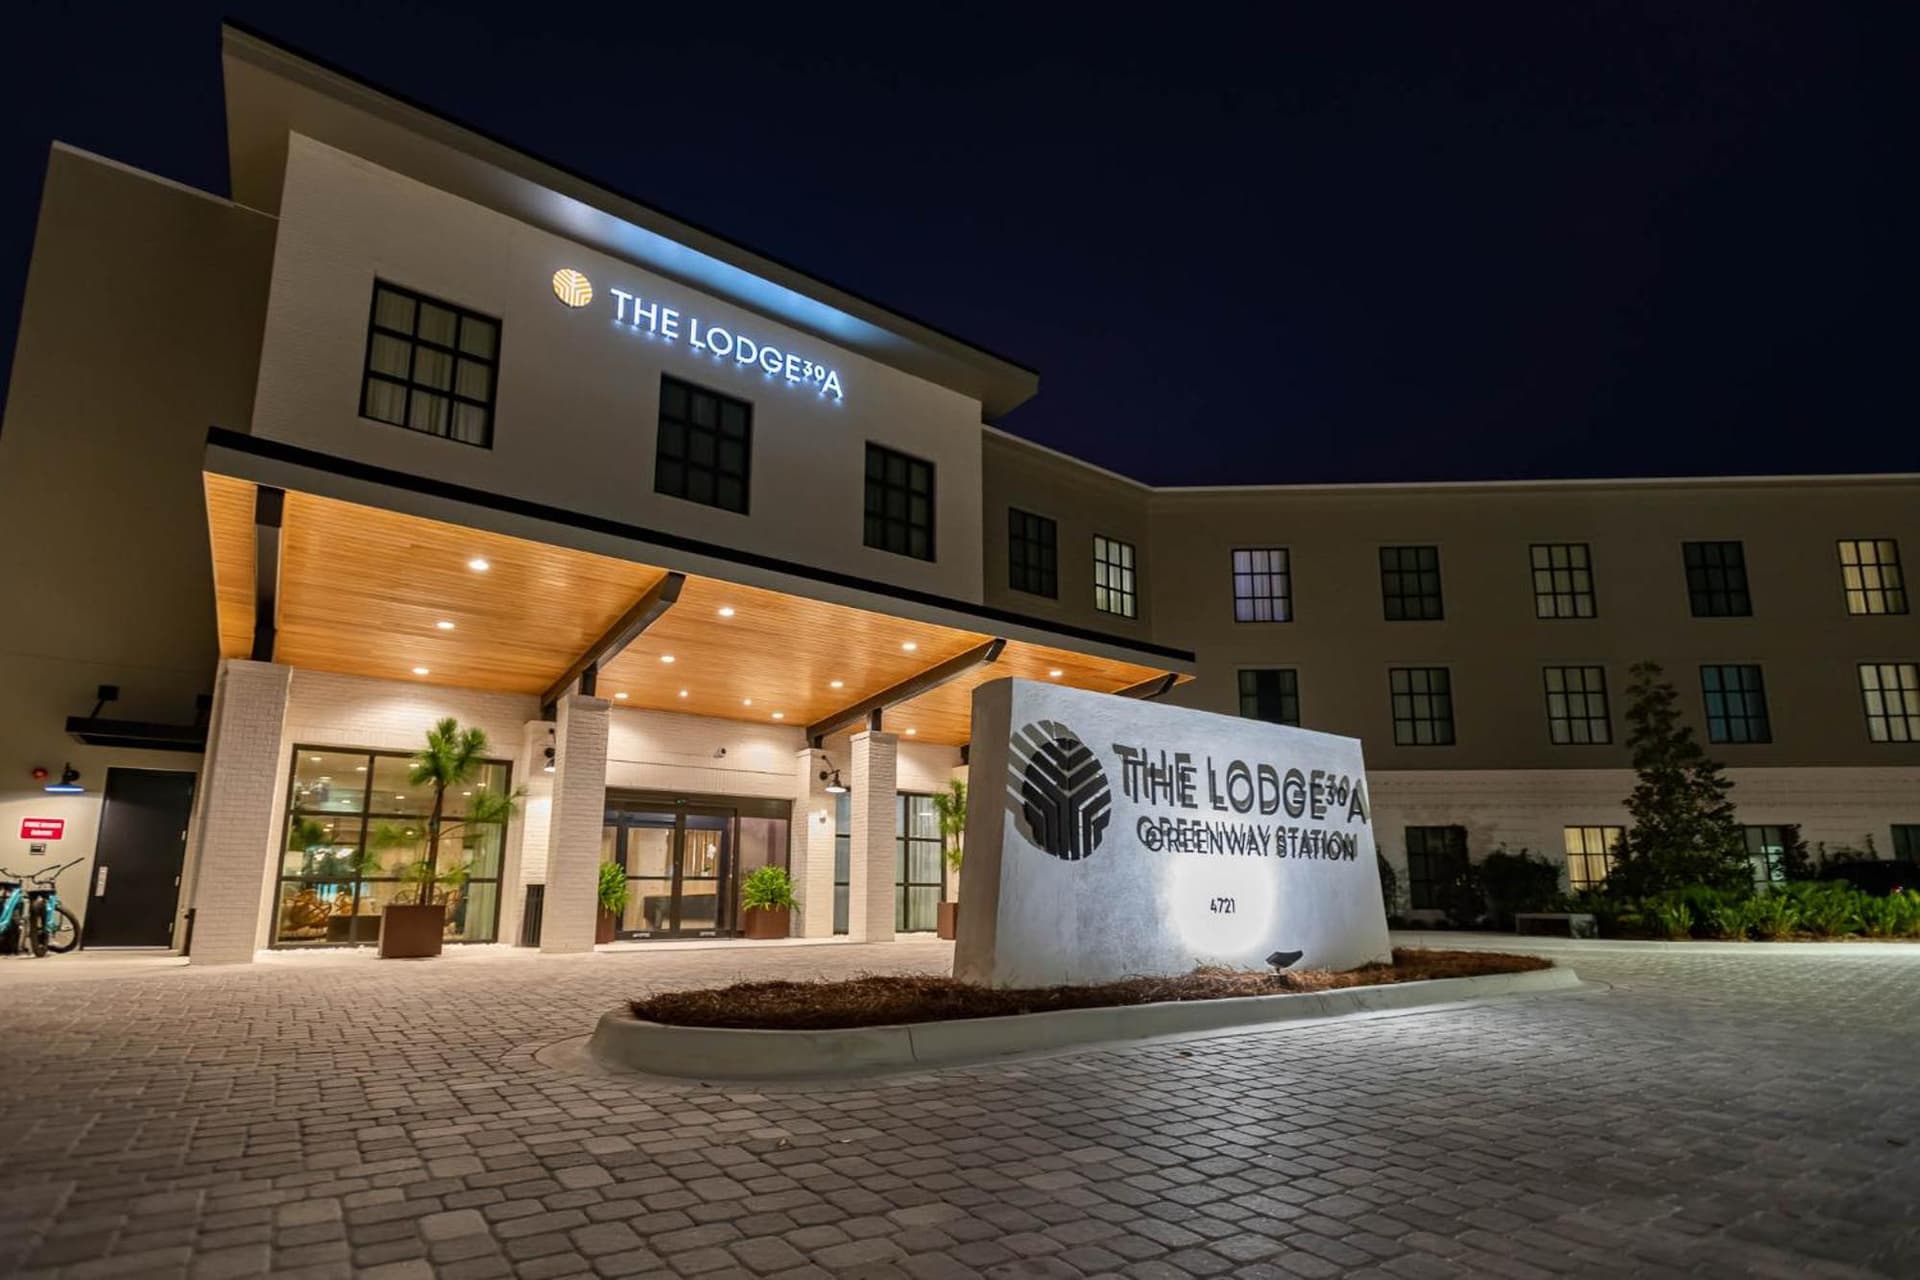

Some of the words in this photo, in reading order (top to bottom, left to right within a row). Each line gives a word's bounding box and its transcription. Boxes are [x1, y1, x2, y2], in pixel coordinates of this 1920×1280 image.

[610, 288, 679, 338] THE
[1123, 759, 1198, 809] THE
[1145, 825, 1271, 856] GREENWAY
[1276, 834, 1355, 861] STATION
[1210, 897, 1235, 914] 4721
